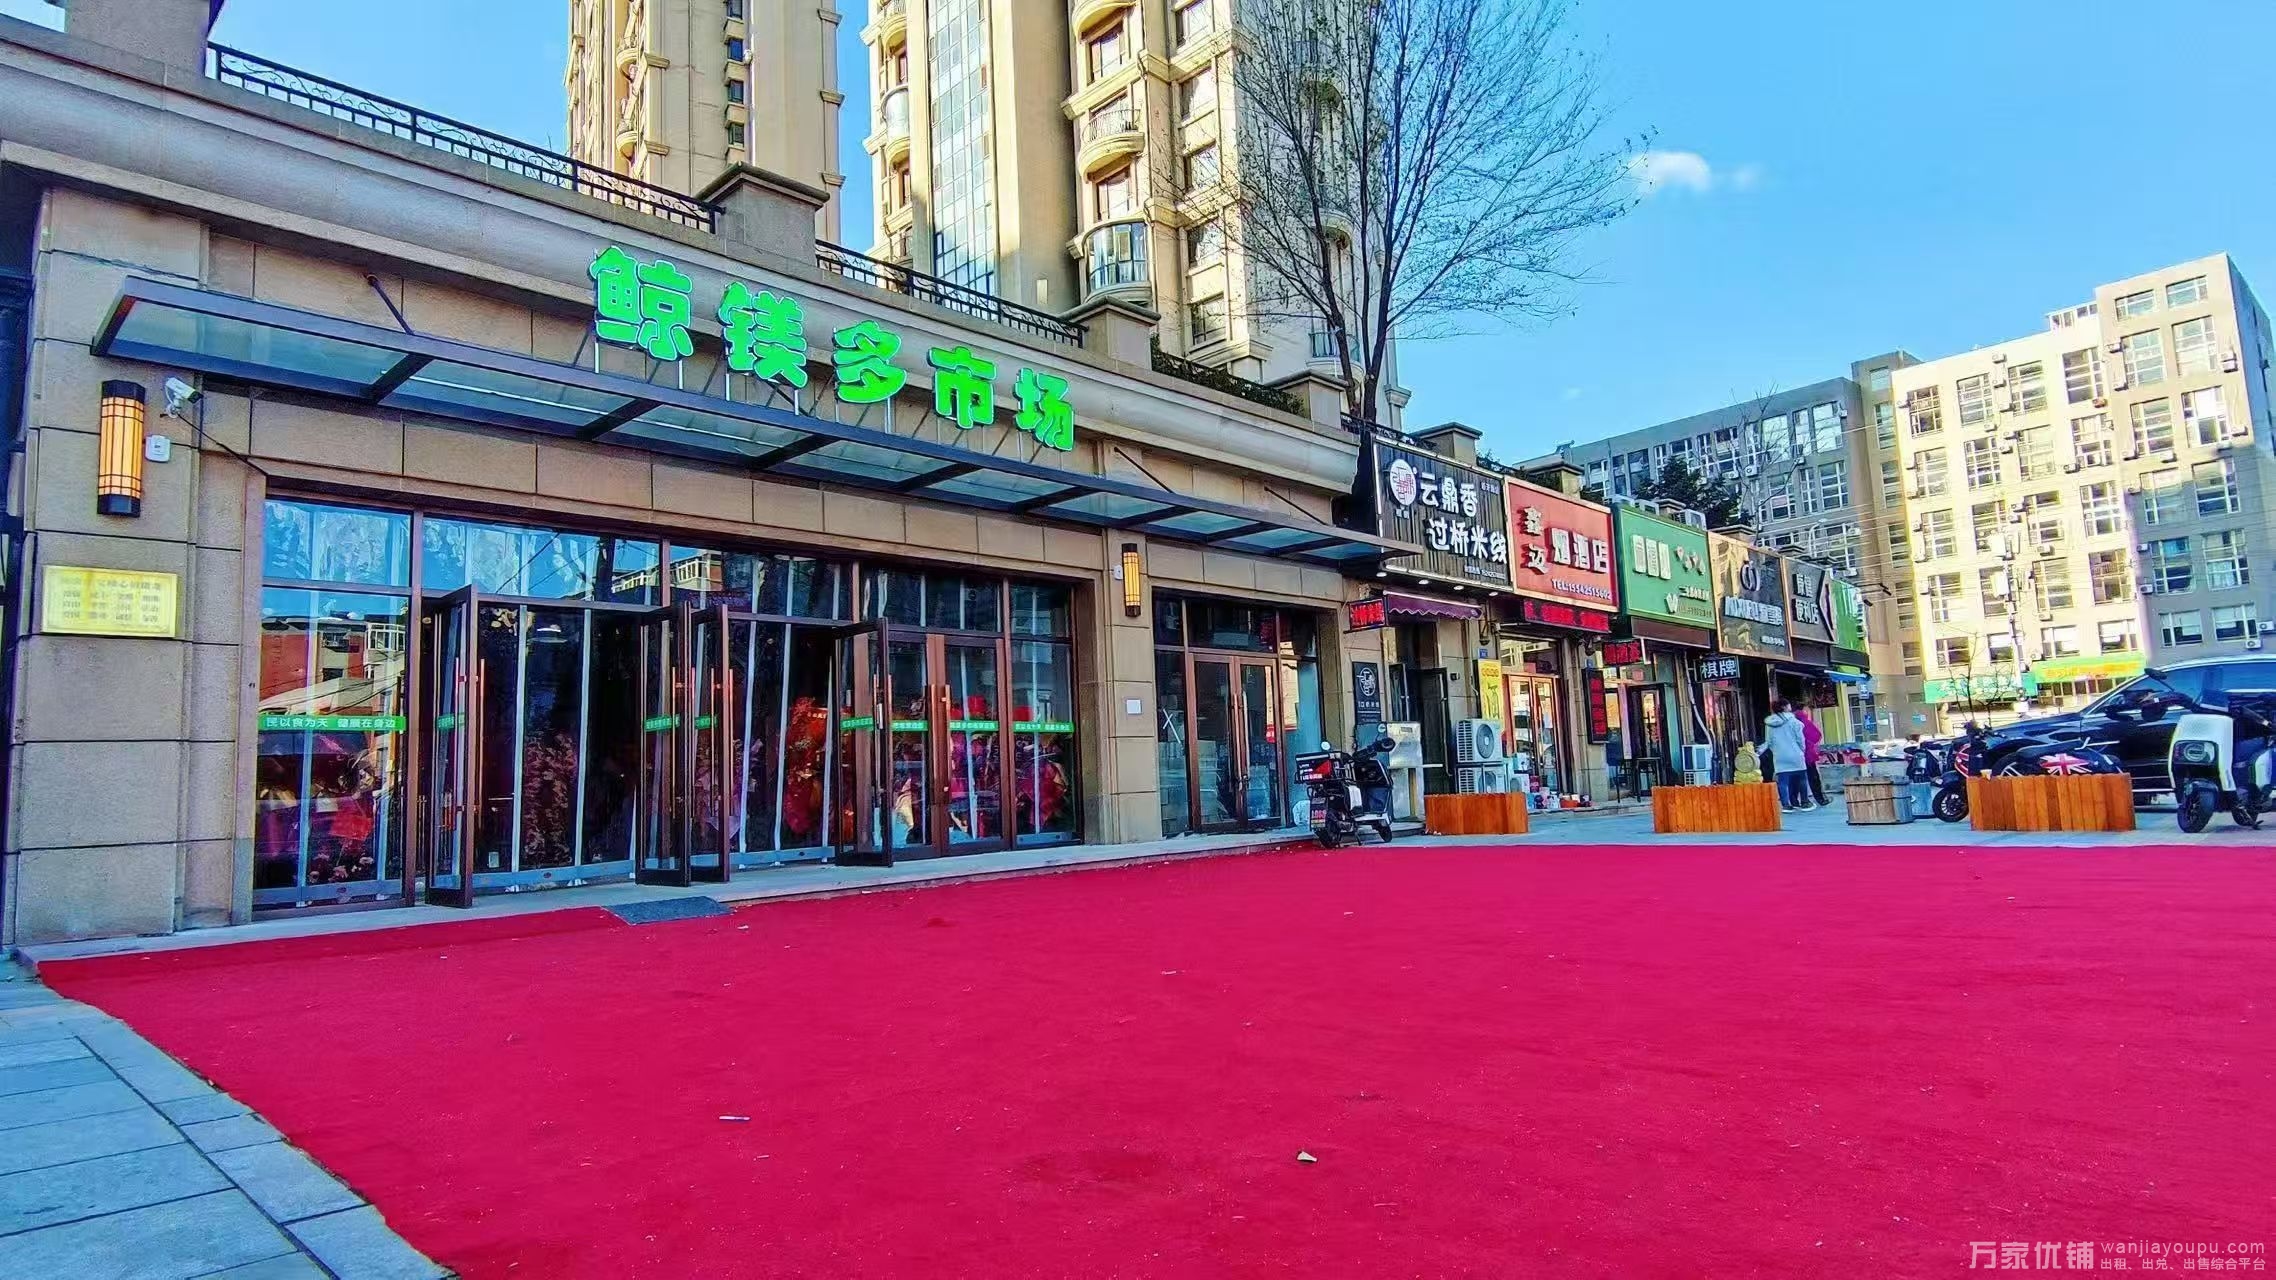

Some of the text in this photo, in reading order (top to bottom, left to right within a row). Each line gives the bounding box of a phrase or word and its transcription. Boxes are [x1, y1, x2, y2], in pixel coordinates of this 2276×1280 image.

[588, 244, 1076, 453] 鲸镁多市场
[1420, 472, 1478, 517] 云鼎香
[1427, 517, 1507, 564] 过桥米线
[1551, 527, 1609, 574] 烟酒店
[1700, 659, 1736, 678] 棋牌
[266, 717, 328, 728] 民以食为天
